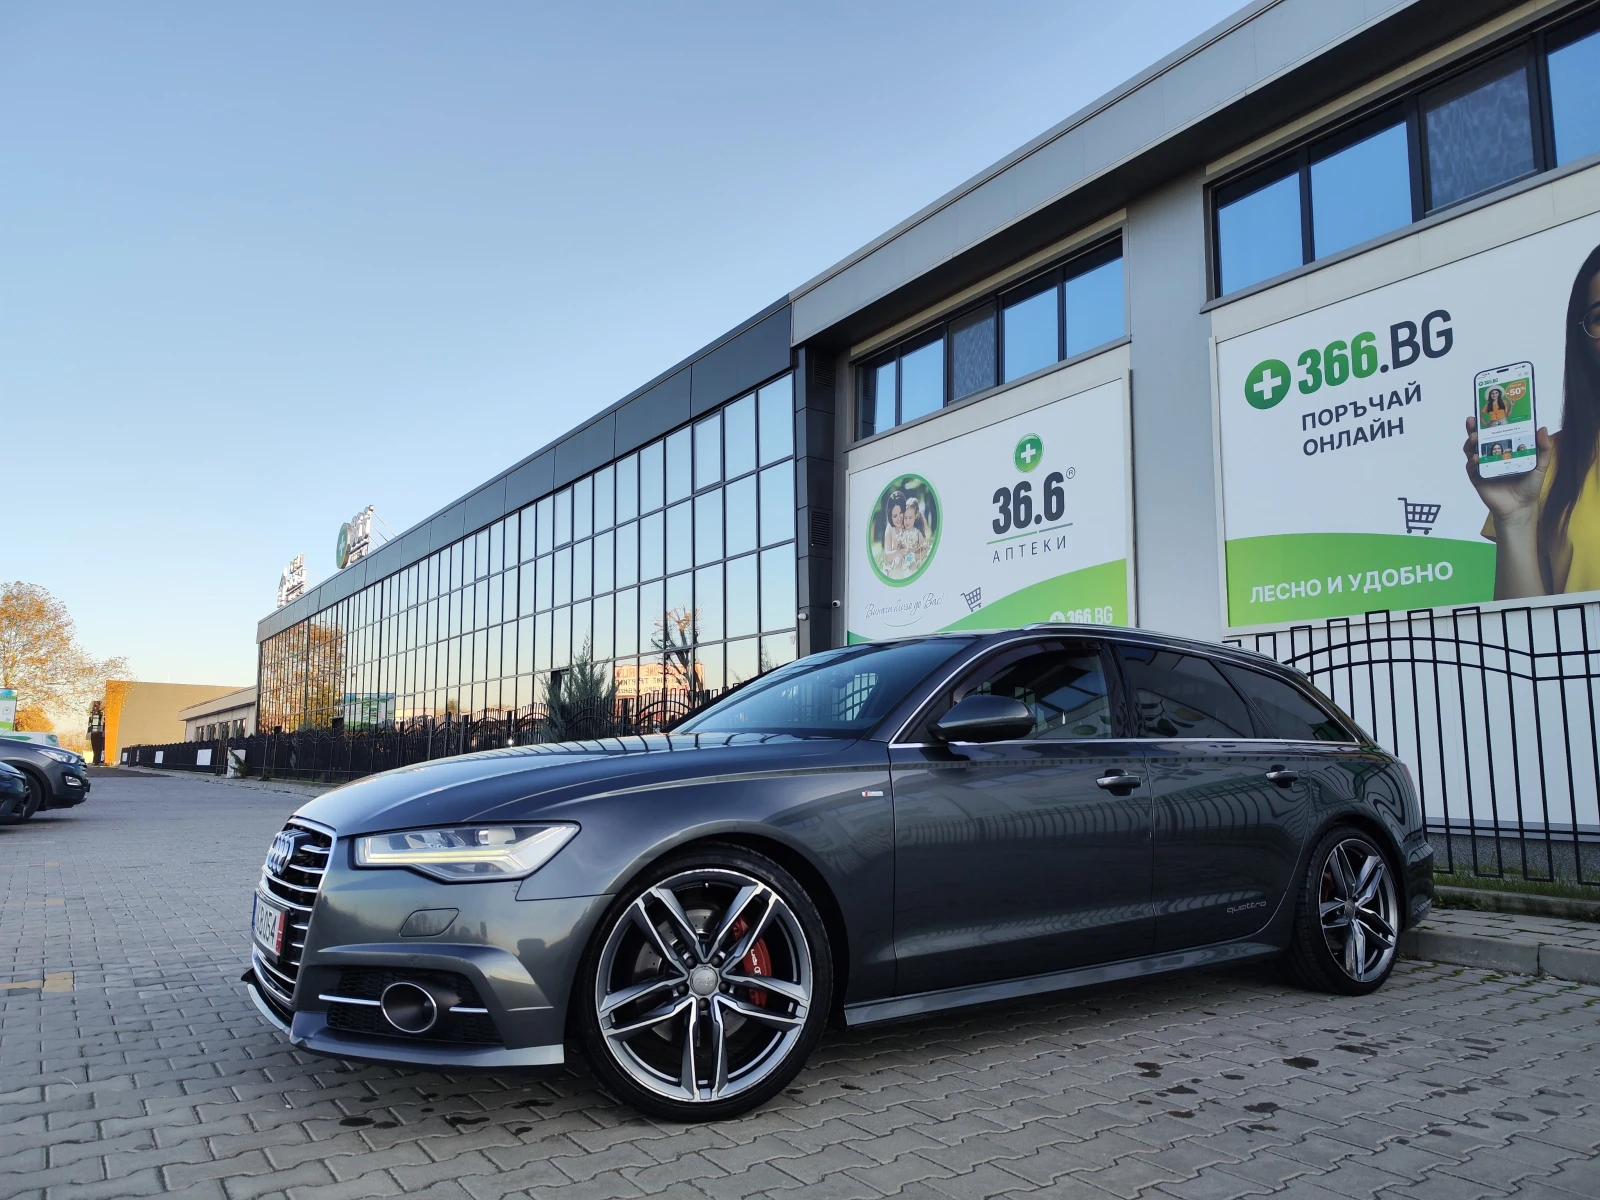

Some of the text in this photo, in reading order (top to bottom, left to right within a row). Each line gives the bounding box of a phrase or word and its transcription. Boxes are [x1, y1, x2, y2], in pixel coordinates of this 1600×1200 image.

[1297, 309, 1454, 395] 366.BG
[1302, 380, 1422, 431] ПОРЪЧАЙ
[1303, 416, 1404, 456] ОНЛАЙН
[992, 471, 1065, 535] 36.6
[992, 535, 1066, 564] АПТЕКИ
[1250, 561, 1454, 604] ЛЕСНО И УДОБНО
[1066, 605, 1113, 625] 366.BG
[1226, 900, 1267, 914] quattro
